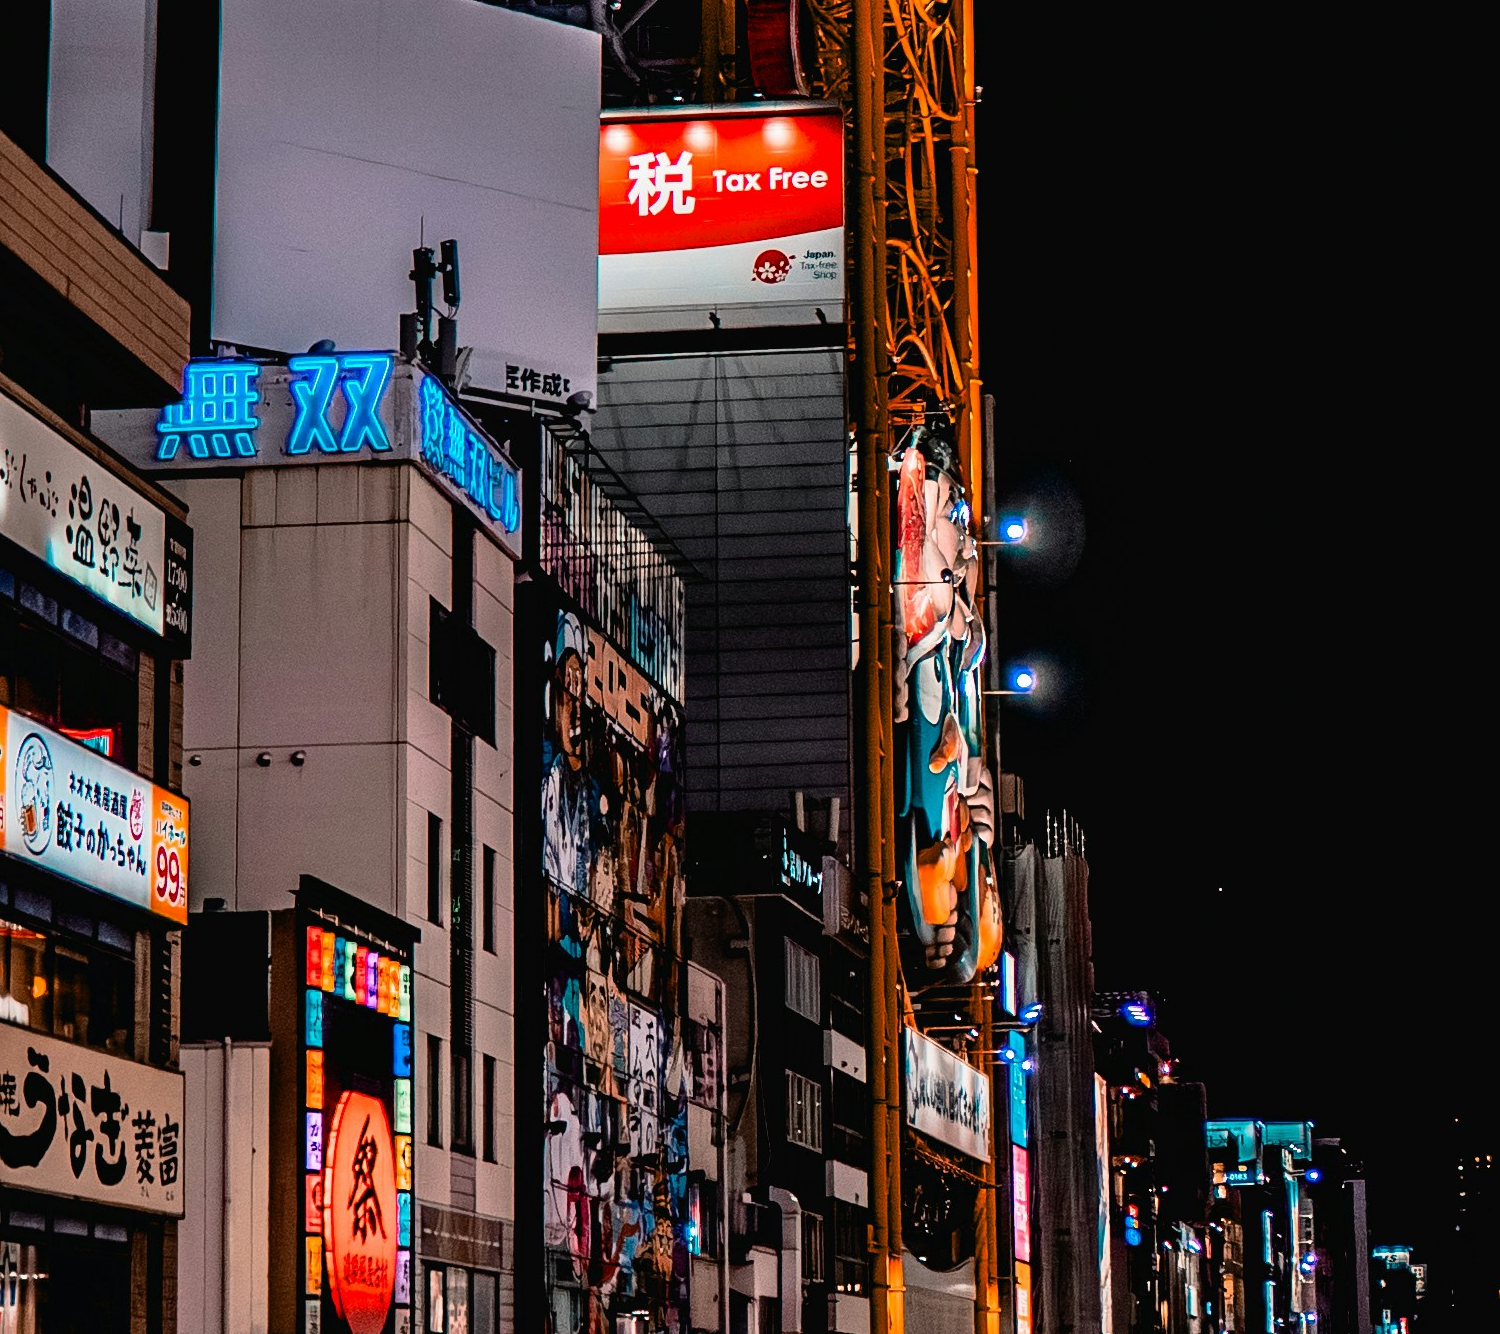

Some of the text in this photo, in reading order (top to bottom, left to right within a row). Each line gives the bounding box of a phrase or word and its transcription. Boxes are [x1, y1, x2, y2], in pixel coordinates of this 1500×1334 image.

[627, 150, 697, 217] 税
[711, 165, 829, 194] Tax Free
[155, 350, 396, 461] 無双
